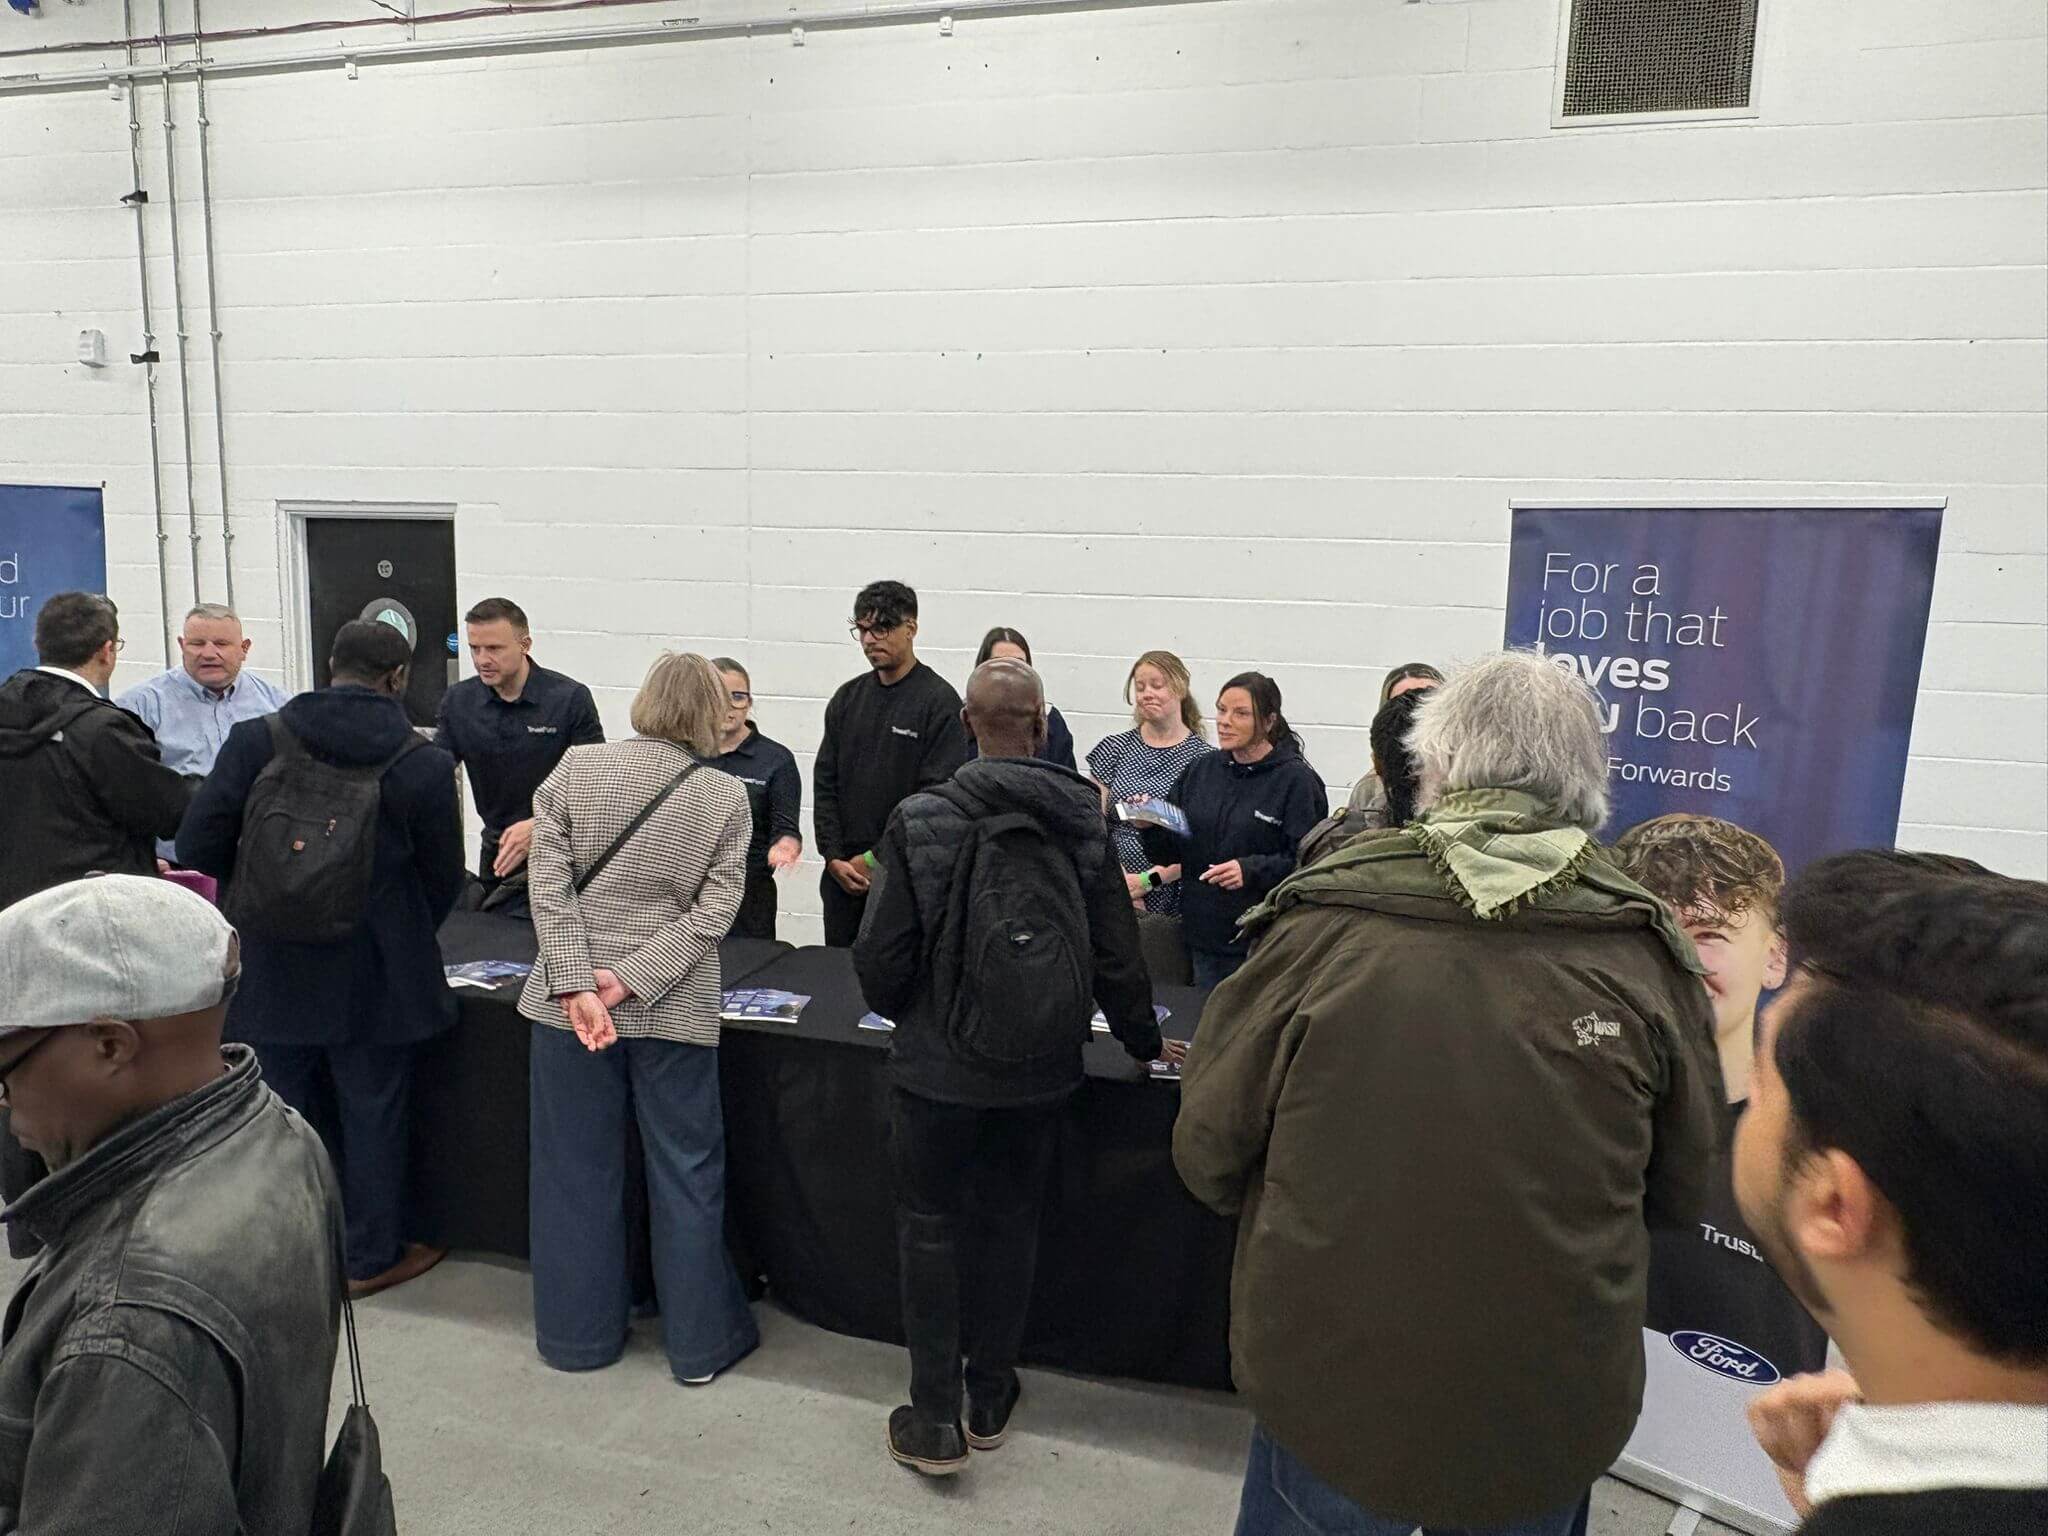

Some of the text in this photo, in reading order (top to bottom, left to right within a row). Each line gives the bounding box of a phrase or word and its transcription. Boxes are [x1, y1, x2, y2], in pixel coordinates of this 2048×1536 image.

[1543, 552, 1661, 596] For a
[1533, 598, 1729, 647] job that
[1635, 694, 1761, 749] back
[1606, 756, 1732, 793] Forwards
[1689, 1336, 1759, 1378] Ford
